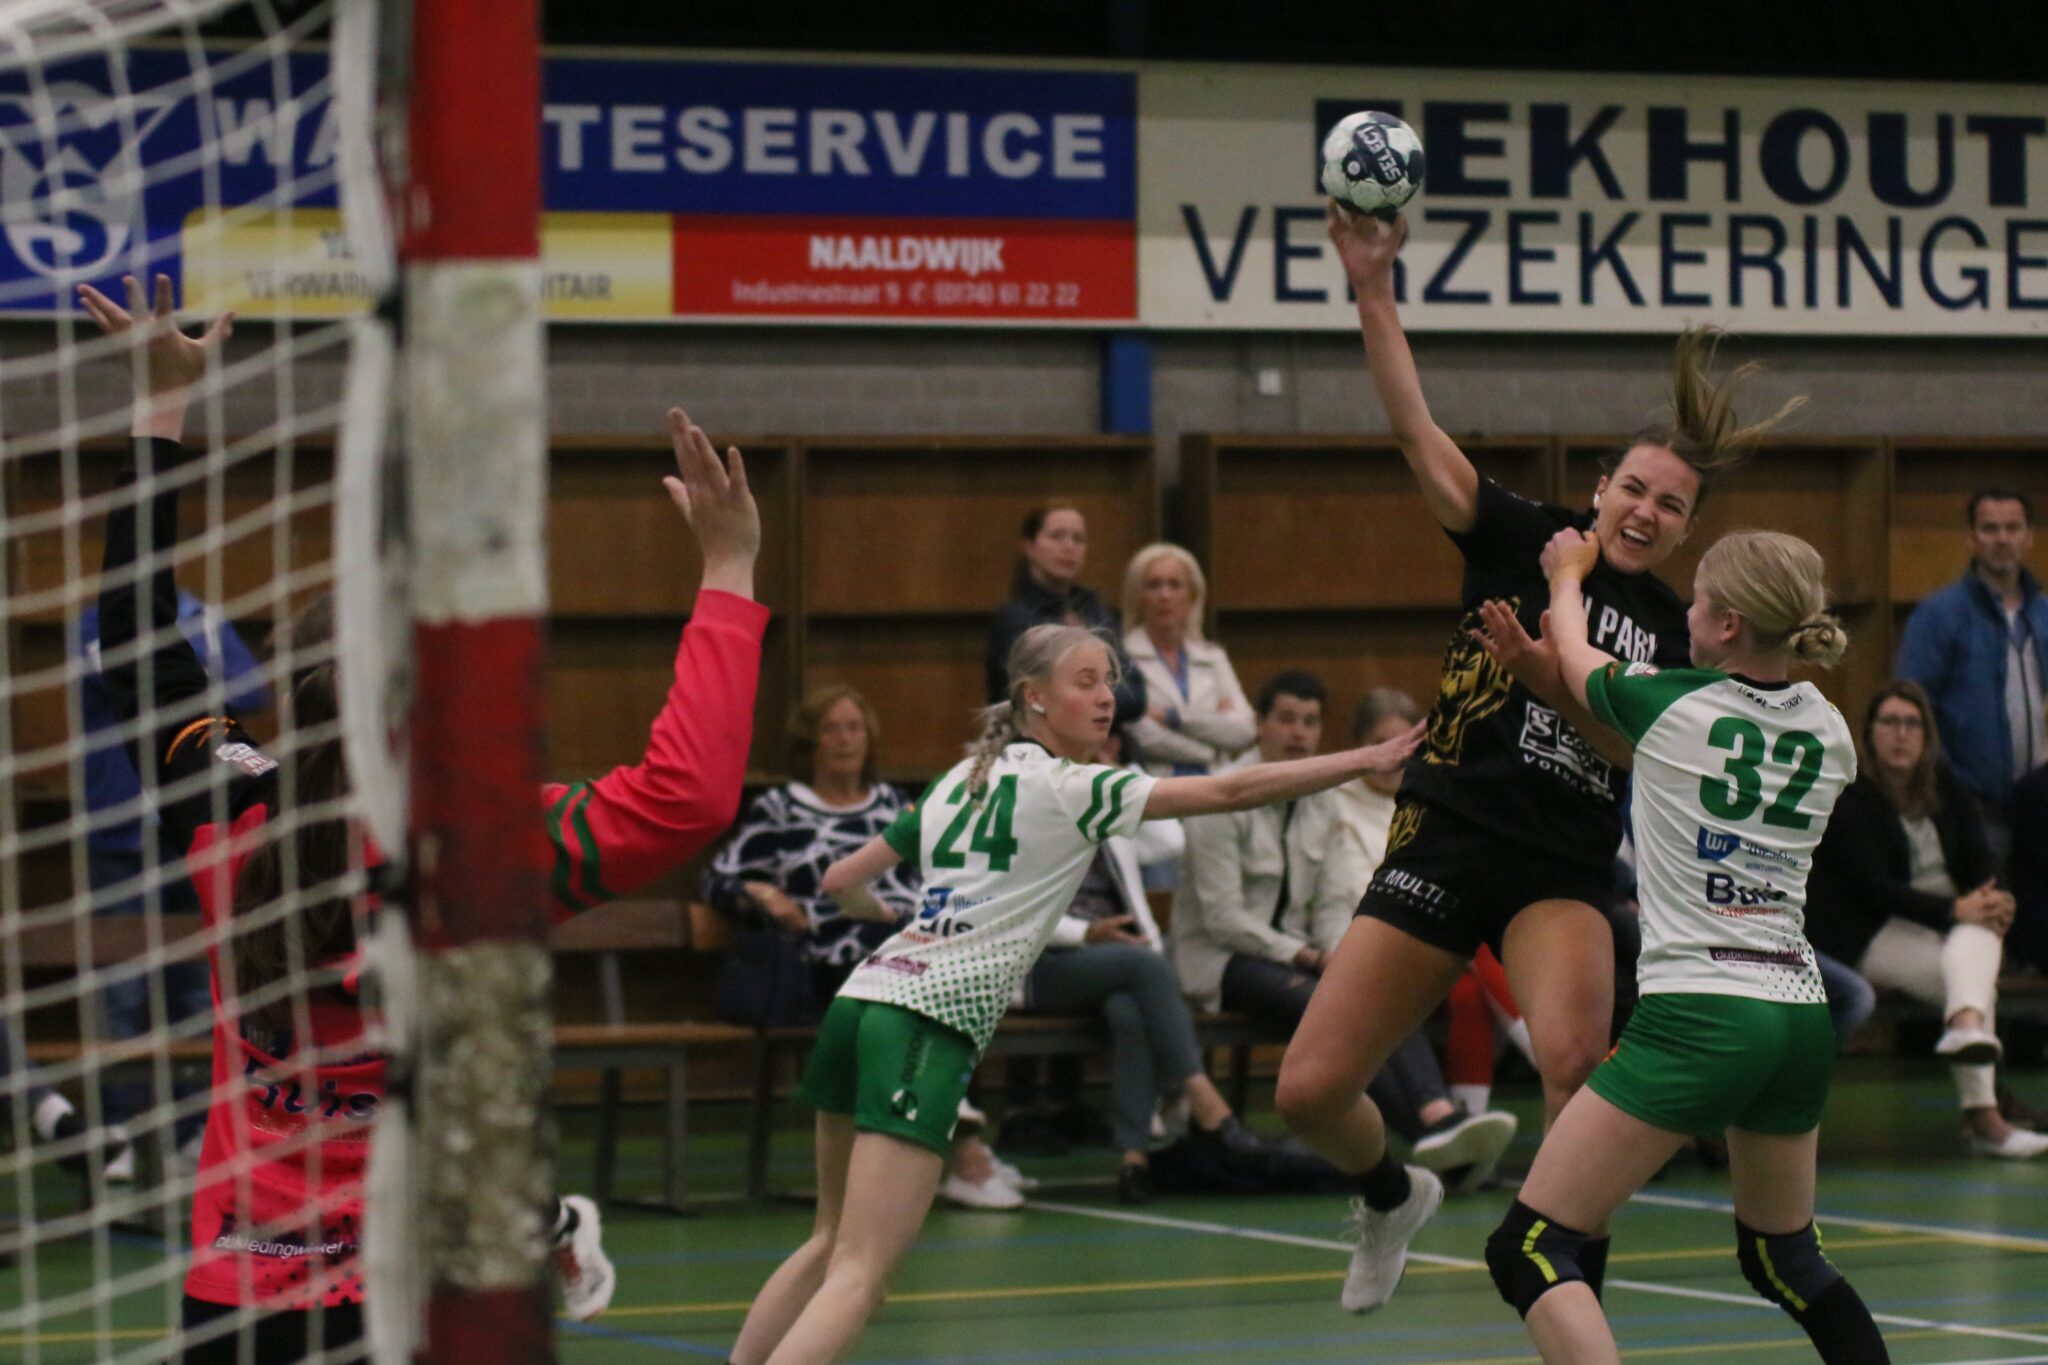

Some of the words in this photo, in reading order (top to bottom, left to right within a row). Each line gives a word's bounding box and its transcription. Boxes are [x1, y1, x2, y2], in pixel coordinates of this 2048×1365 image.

[1315, 98, 2047, 209] EKHOUT
[1356, 124, 1402, 182] SELECT
[808, 234, 1005, 277] NAALDWIJK
[730, 278, 881, 304] Industriestraat
[1025, 282, 1049, 307] 22
[1055, 282, 1080, 308] 22
[1700, 716, 1825, 830] 32
[931, 773, 1019, 873] 24
[1384, 868, 1446, 905] MULTI
